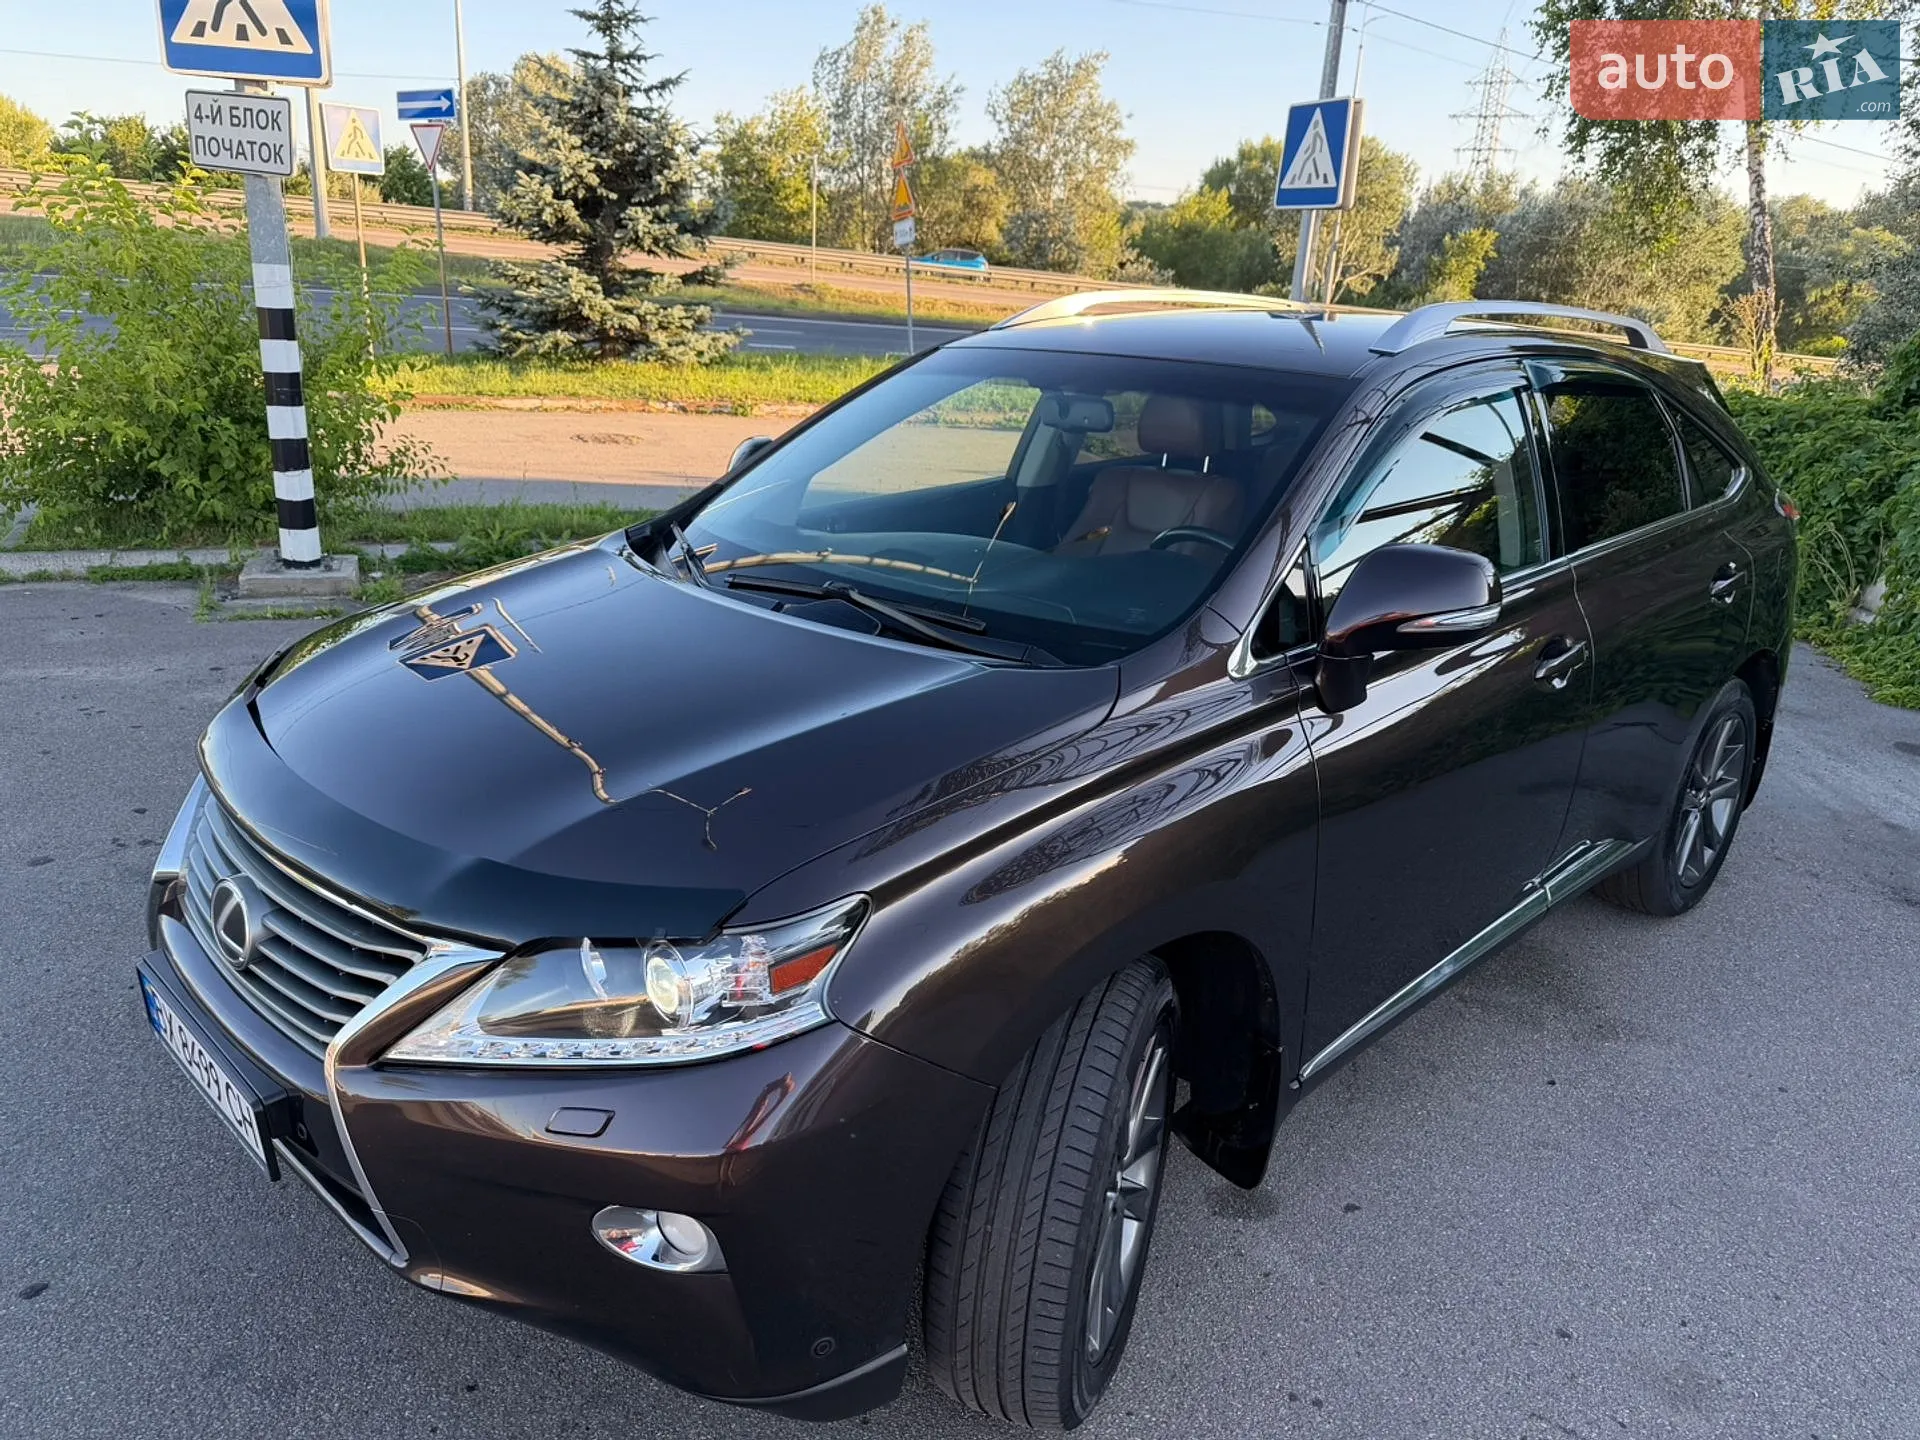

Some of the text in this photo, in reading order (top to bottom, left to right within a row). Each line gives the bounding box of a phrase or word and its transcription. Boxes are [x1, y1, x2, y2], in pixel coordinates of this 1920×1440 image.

[194, 98, 282, 132] 4-Й БЛОК
[194, 134, 285, 165] ПОЧАТОК
[177, 1023, 222, 1103] 8499
[224, 1080, 260, 1148] CH
